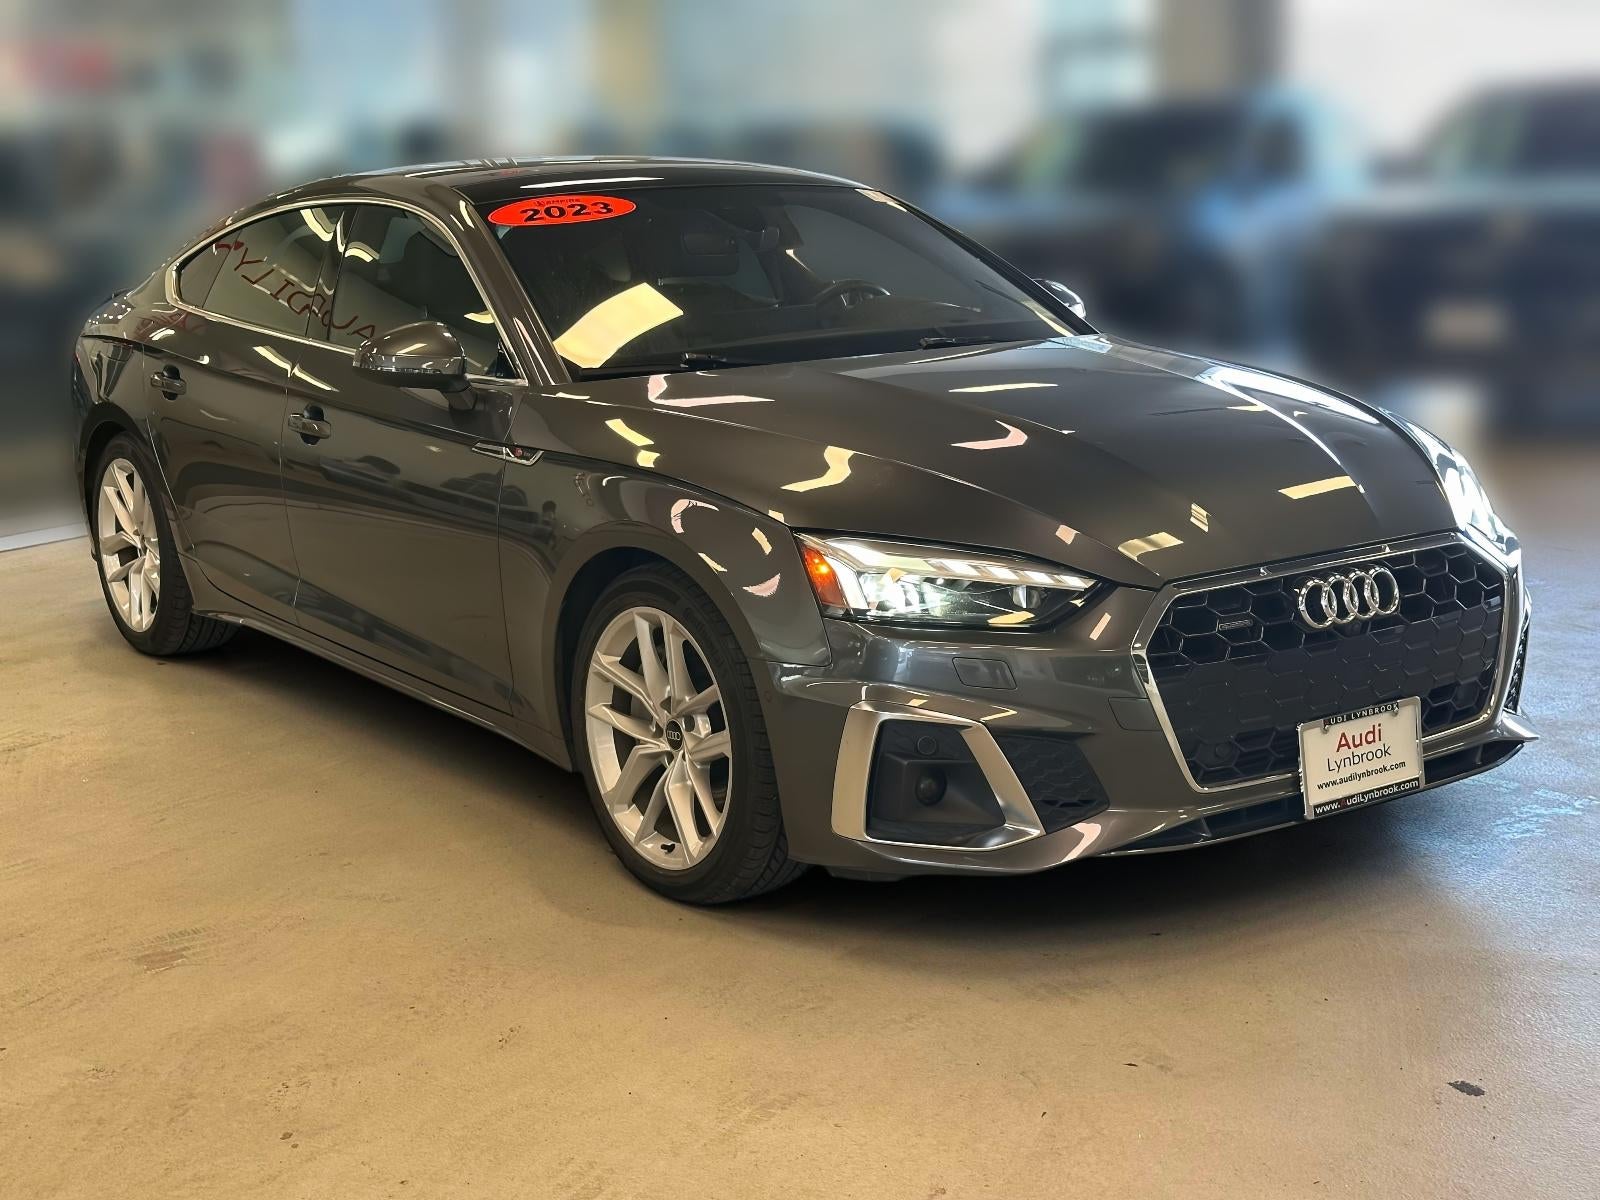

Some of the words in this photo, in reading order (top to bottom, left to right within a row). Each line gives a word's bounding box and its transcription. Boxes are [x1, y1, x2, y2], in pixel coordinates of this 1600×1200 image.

[520, 202, 613, 222] 2023
[1336, 723, 1382, 753] Audi
[1327, 743, 1392, 774] Lynbrook
[1317, 760, 1406, 790] www.audilynbrook.com
